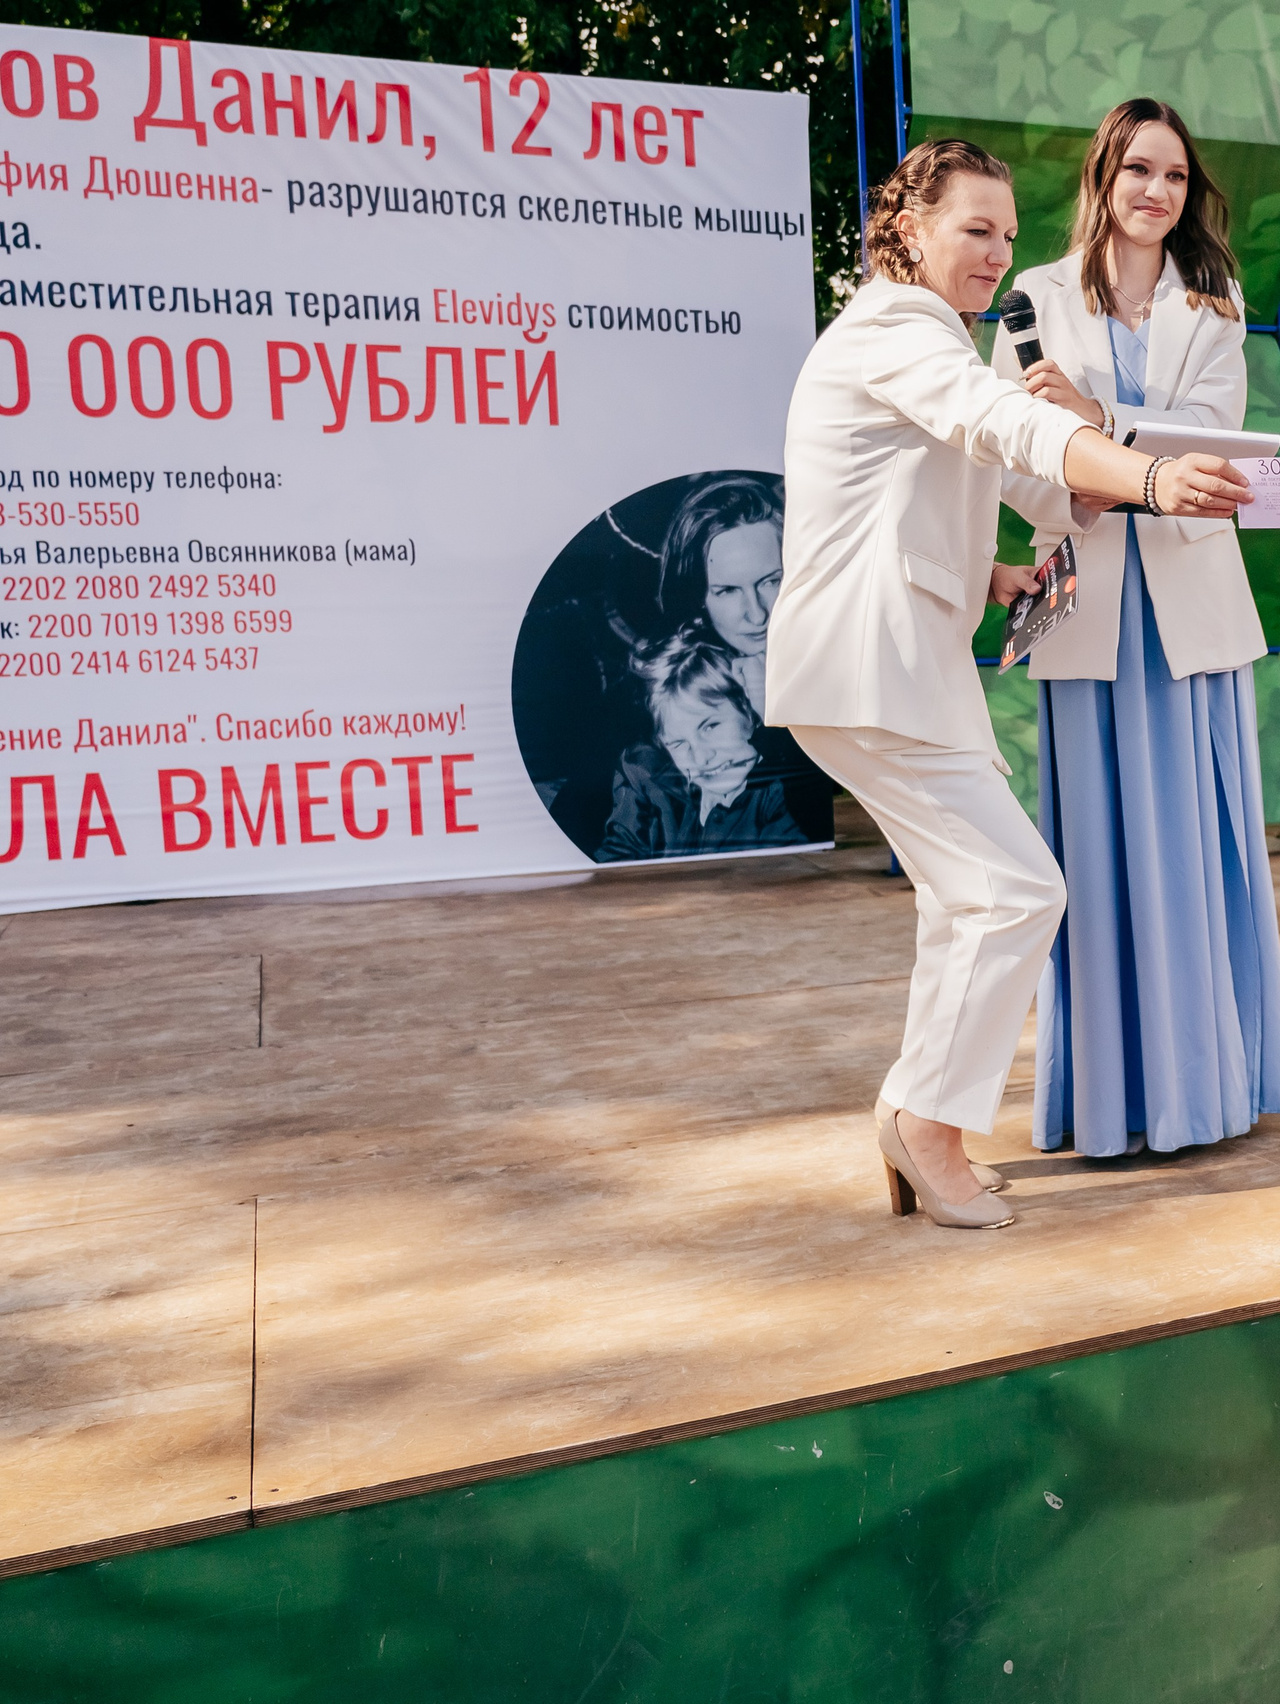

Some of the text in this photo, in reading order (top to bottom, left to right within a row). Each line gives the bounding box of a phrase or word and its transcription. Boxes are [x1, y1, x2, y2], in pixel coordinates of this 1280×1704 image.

[0, 36, 704, 168] ов Данил, 12 лет
[0, 150, 69, 197] фия
[287, 179, 506, 218] разрушаются
[518, 194, 683, 229] скелетные
[694, 206, 806, 241] мышцы
[0, 279, 742, 335] аместительная терапия Elevidys стоимостью
[68, 333, 233, 420] 000
[266, 331, 560, 434] РУБЛЕЙ
[32, 470, 60, 488] по
[69, 470, 155, 493] номеру
[163, 465, 282, 494] телефона:
[0, 538, 416, 569] ья Валерьевна Овсянникова (мама)
[2, 573, 277, 601] 2202 2080 2492 5340
[0, 609, 293, 639] к: 2200 7019 1398 6599
[0, 646, 259, 677] 2200 2414 6124 5437
[216, 709, 332, 742] Спасибо
[343, 703, 467, 739] каждому!
[0, 753, 479, 864] ЛА ВМЕСТЕ
